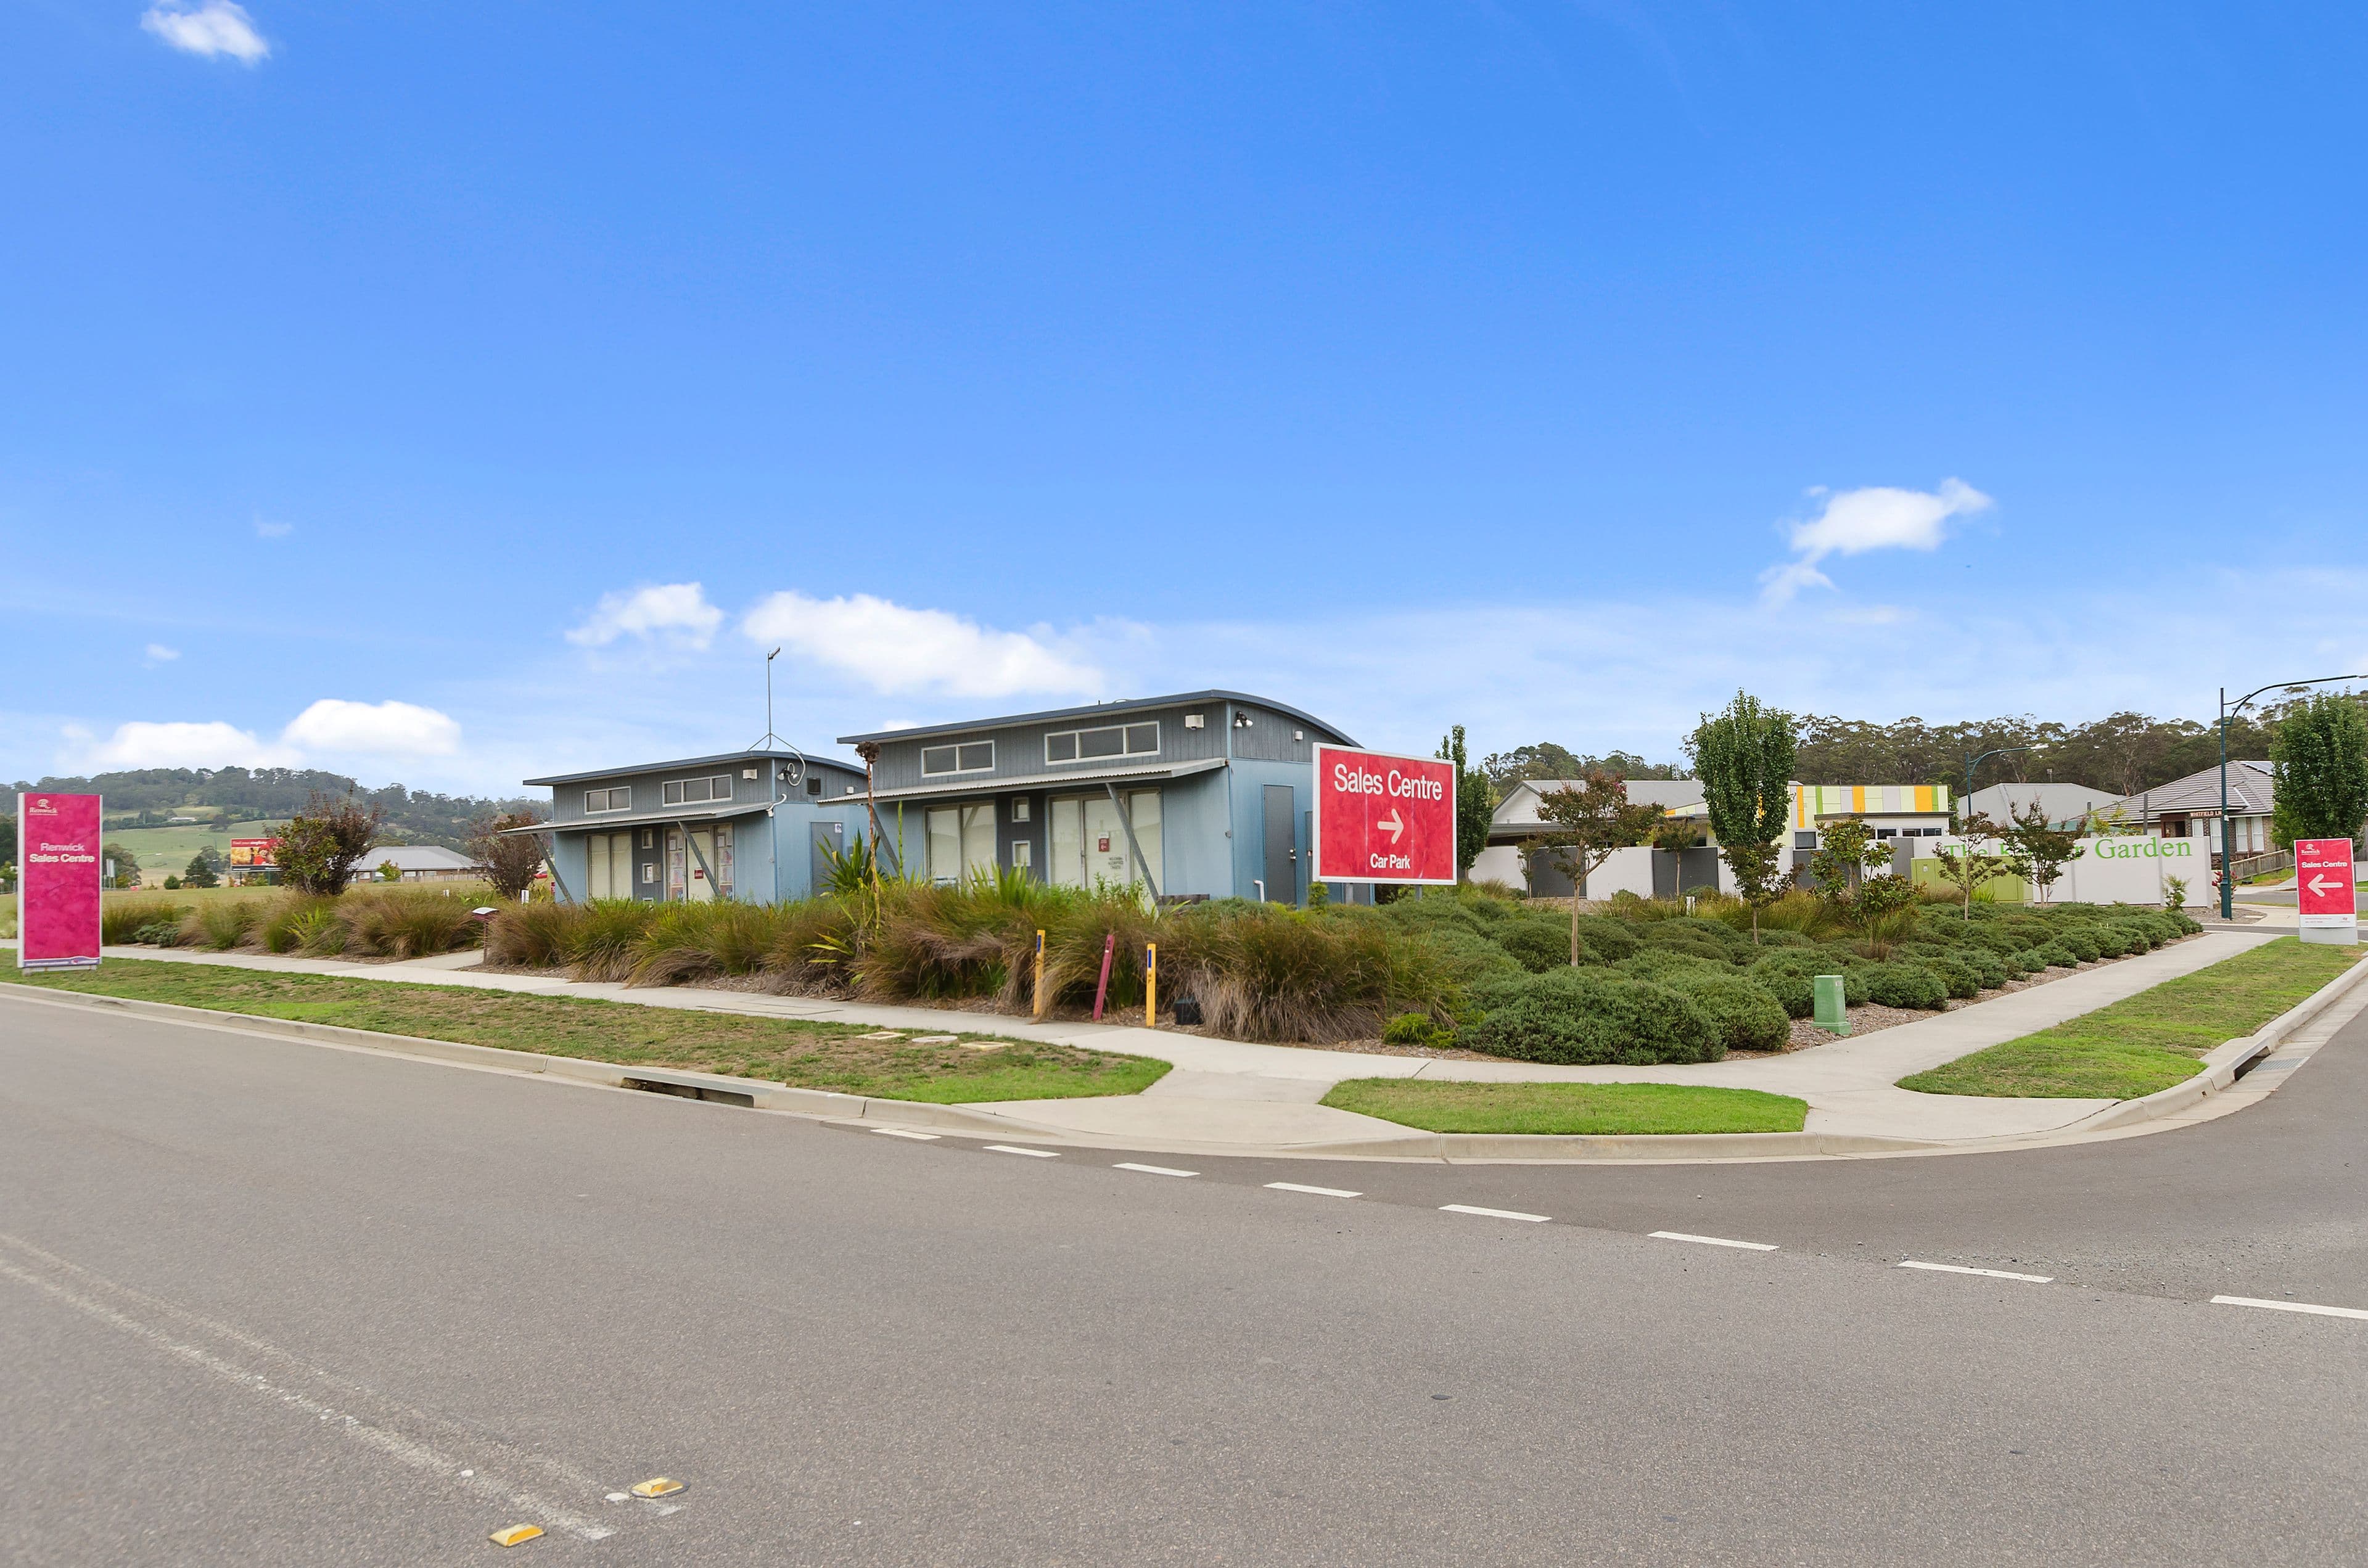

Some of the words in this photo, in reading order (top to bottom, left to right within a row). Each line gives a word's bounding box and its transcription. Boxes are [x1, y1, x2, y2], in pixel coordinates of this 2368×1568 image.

[1334, 763, 1384, 795] Sales
[1388, 770, 1442, 801] Centre
[40, 842, 85, 852] Renwick
[2095, 836, 2193, 859] Garden
[29, 853, 60, 863] Sales
[60, 853, 95, 863] Centre
[1370, 853, 1388, 869] Car
[1389, 853, 1410, 869] Park
